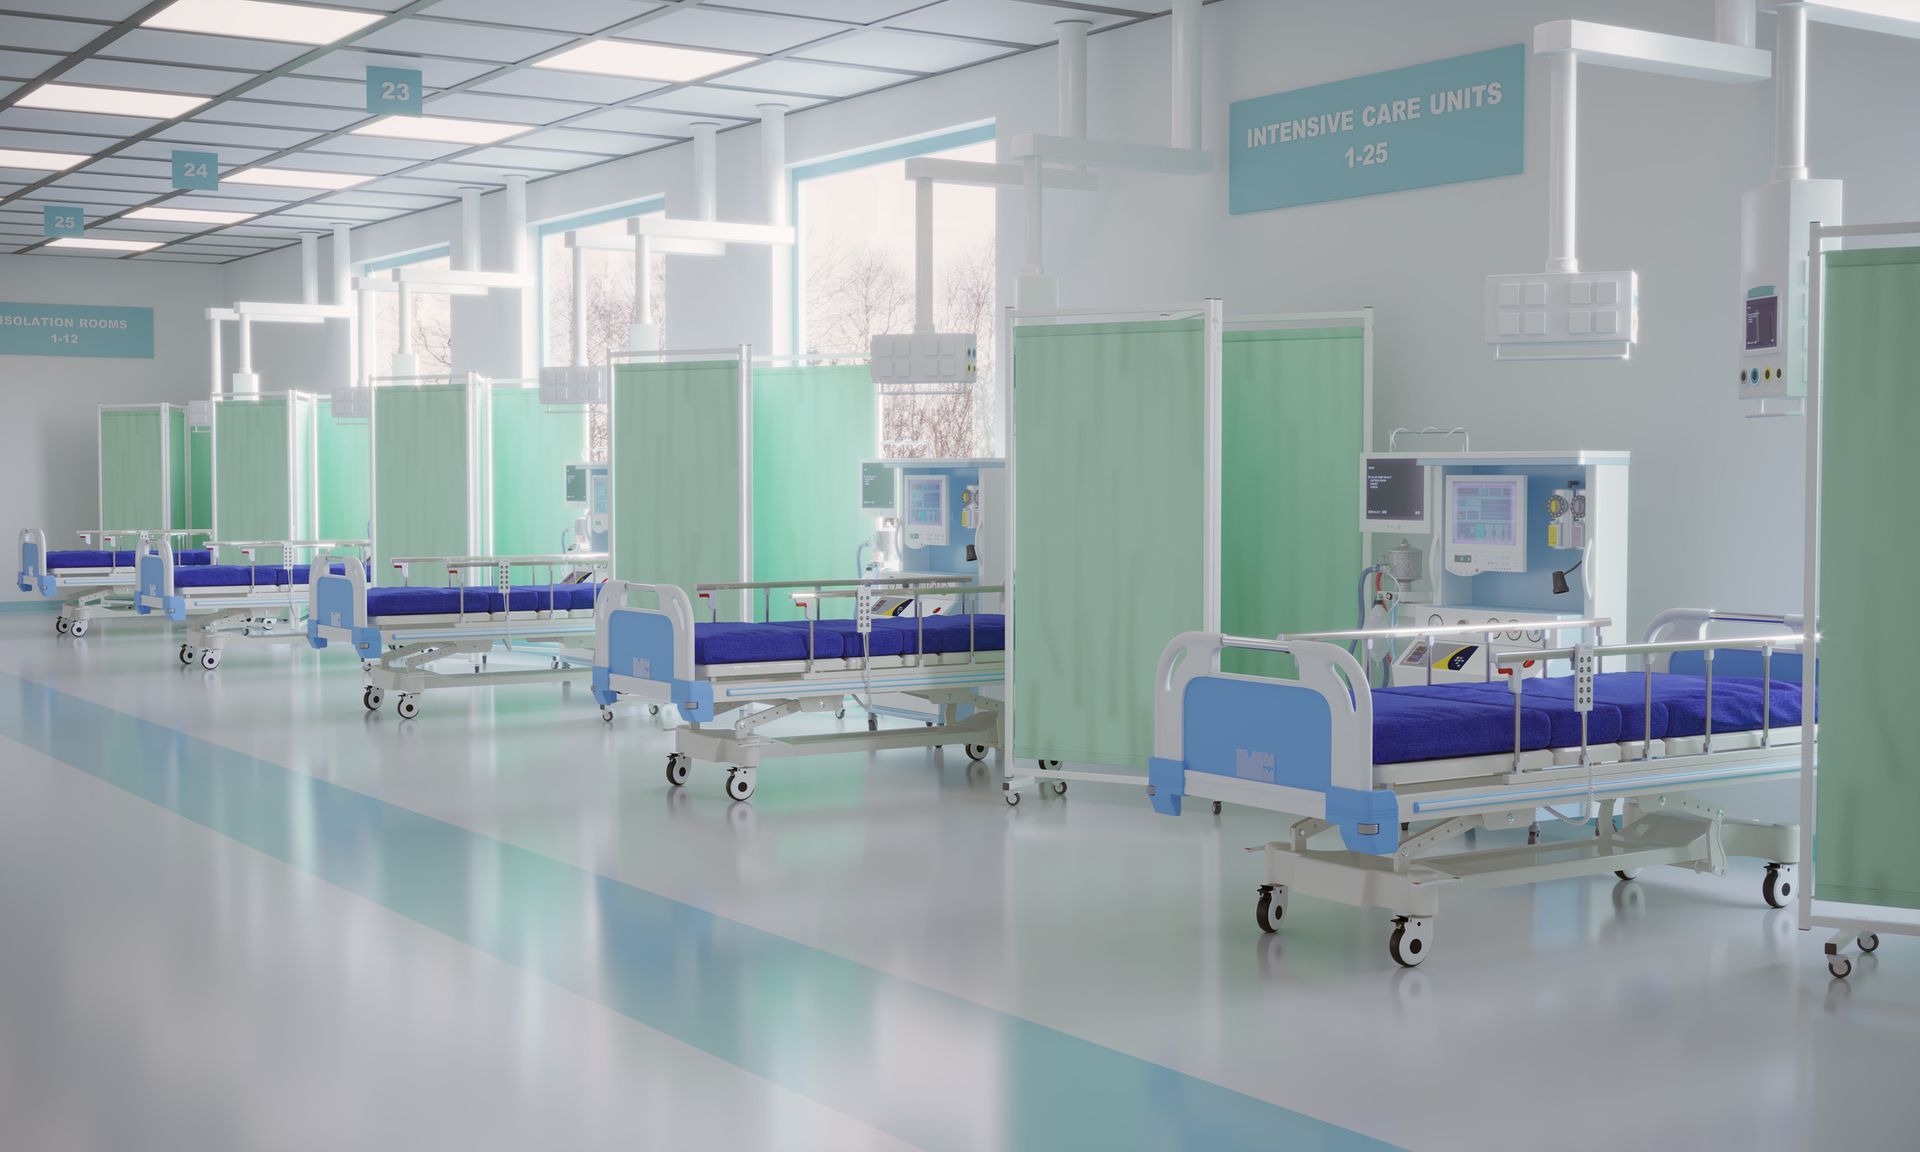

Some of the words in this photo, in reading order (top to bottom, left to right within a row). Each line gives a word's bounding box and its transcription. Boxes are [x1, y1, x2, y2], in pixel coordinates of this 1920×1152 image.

[382, 81, 410, 101] 23
[1247, 110, 1354, 148] INTENSIVE
[1362, 97, 1421, 128] CARE
[1430, 82, 1503, 115] UNITS
[1344, 142, 1388, 168] 1-25
[183, 162, 208, 178] 24
[55, 216, 75, 229] 25
[79, 318, 128, 329] ROOMS
[51, 334, 79, 344] 1-12
